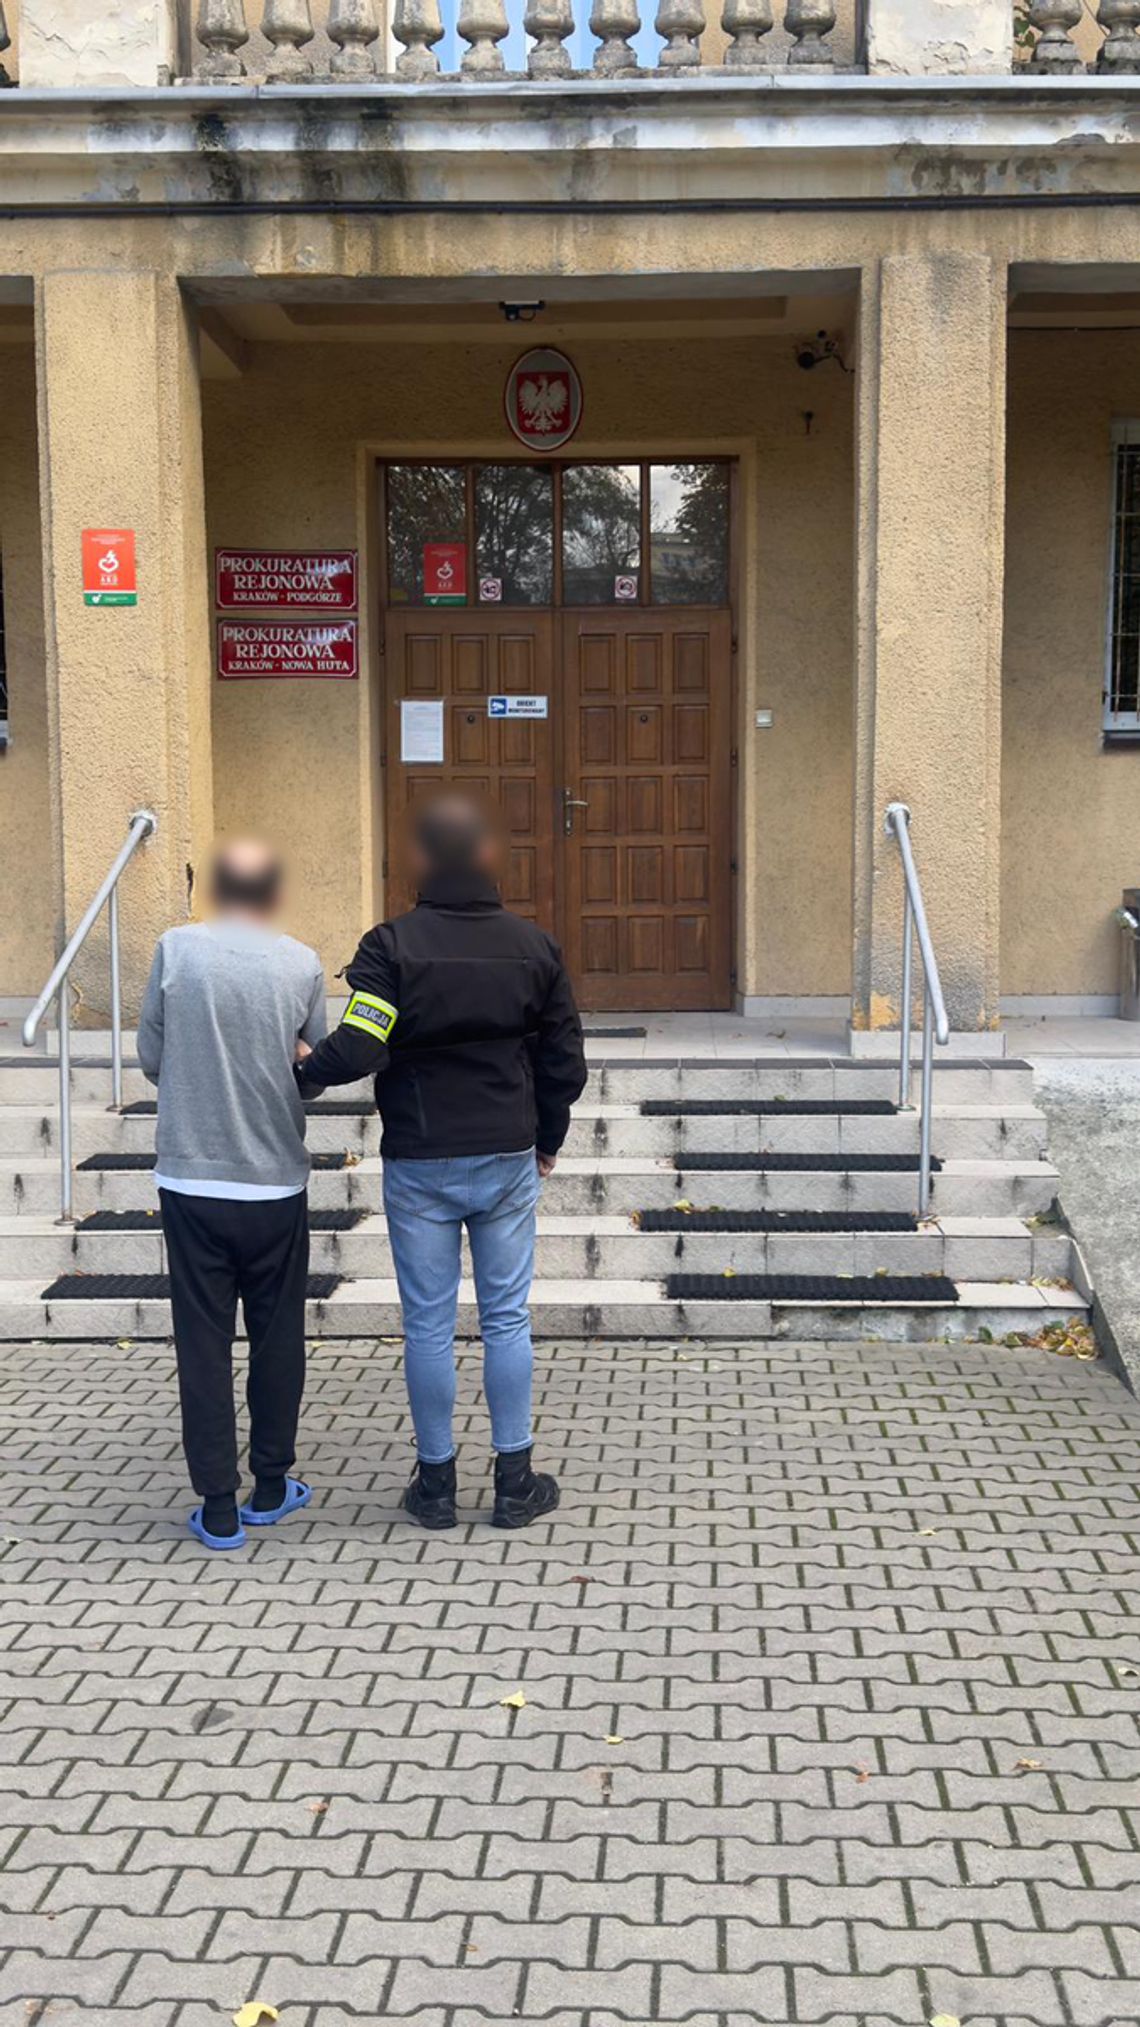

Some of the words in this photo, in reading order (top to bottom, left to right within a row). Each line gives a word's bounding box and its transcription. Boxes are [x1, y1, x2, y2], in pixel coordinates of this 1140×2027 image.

[220, 557, 352, 574] PROKURATURA
[233, 574, 334, 590] REJONOWA
[233, 591, 279, 602] KRAKÓW
[287, 591, 342, 603] PODGÓRZE
[222, 626, 352, 642] PROKURATURA
[236, 643, 335, 659] REJONOWA
[228, 659, 273, 671] KRAKÓW
[282, 660, 313, 671] NOWA
[317, 660, 349, 671] HUTA
[352, 1002, 389, 1028] POLICJA
